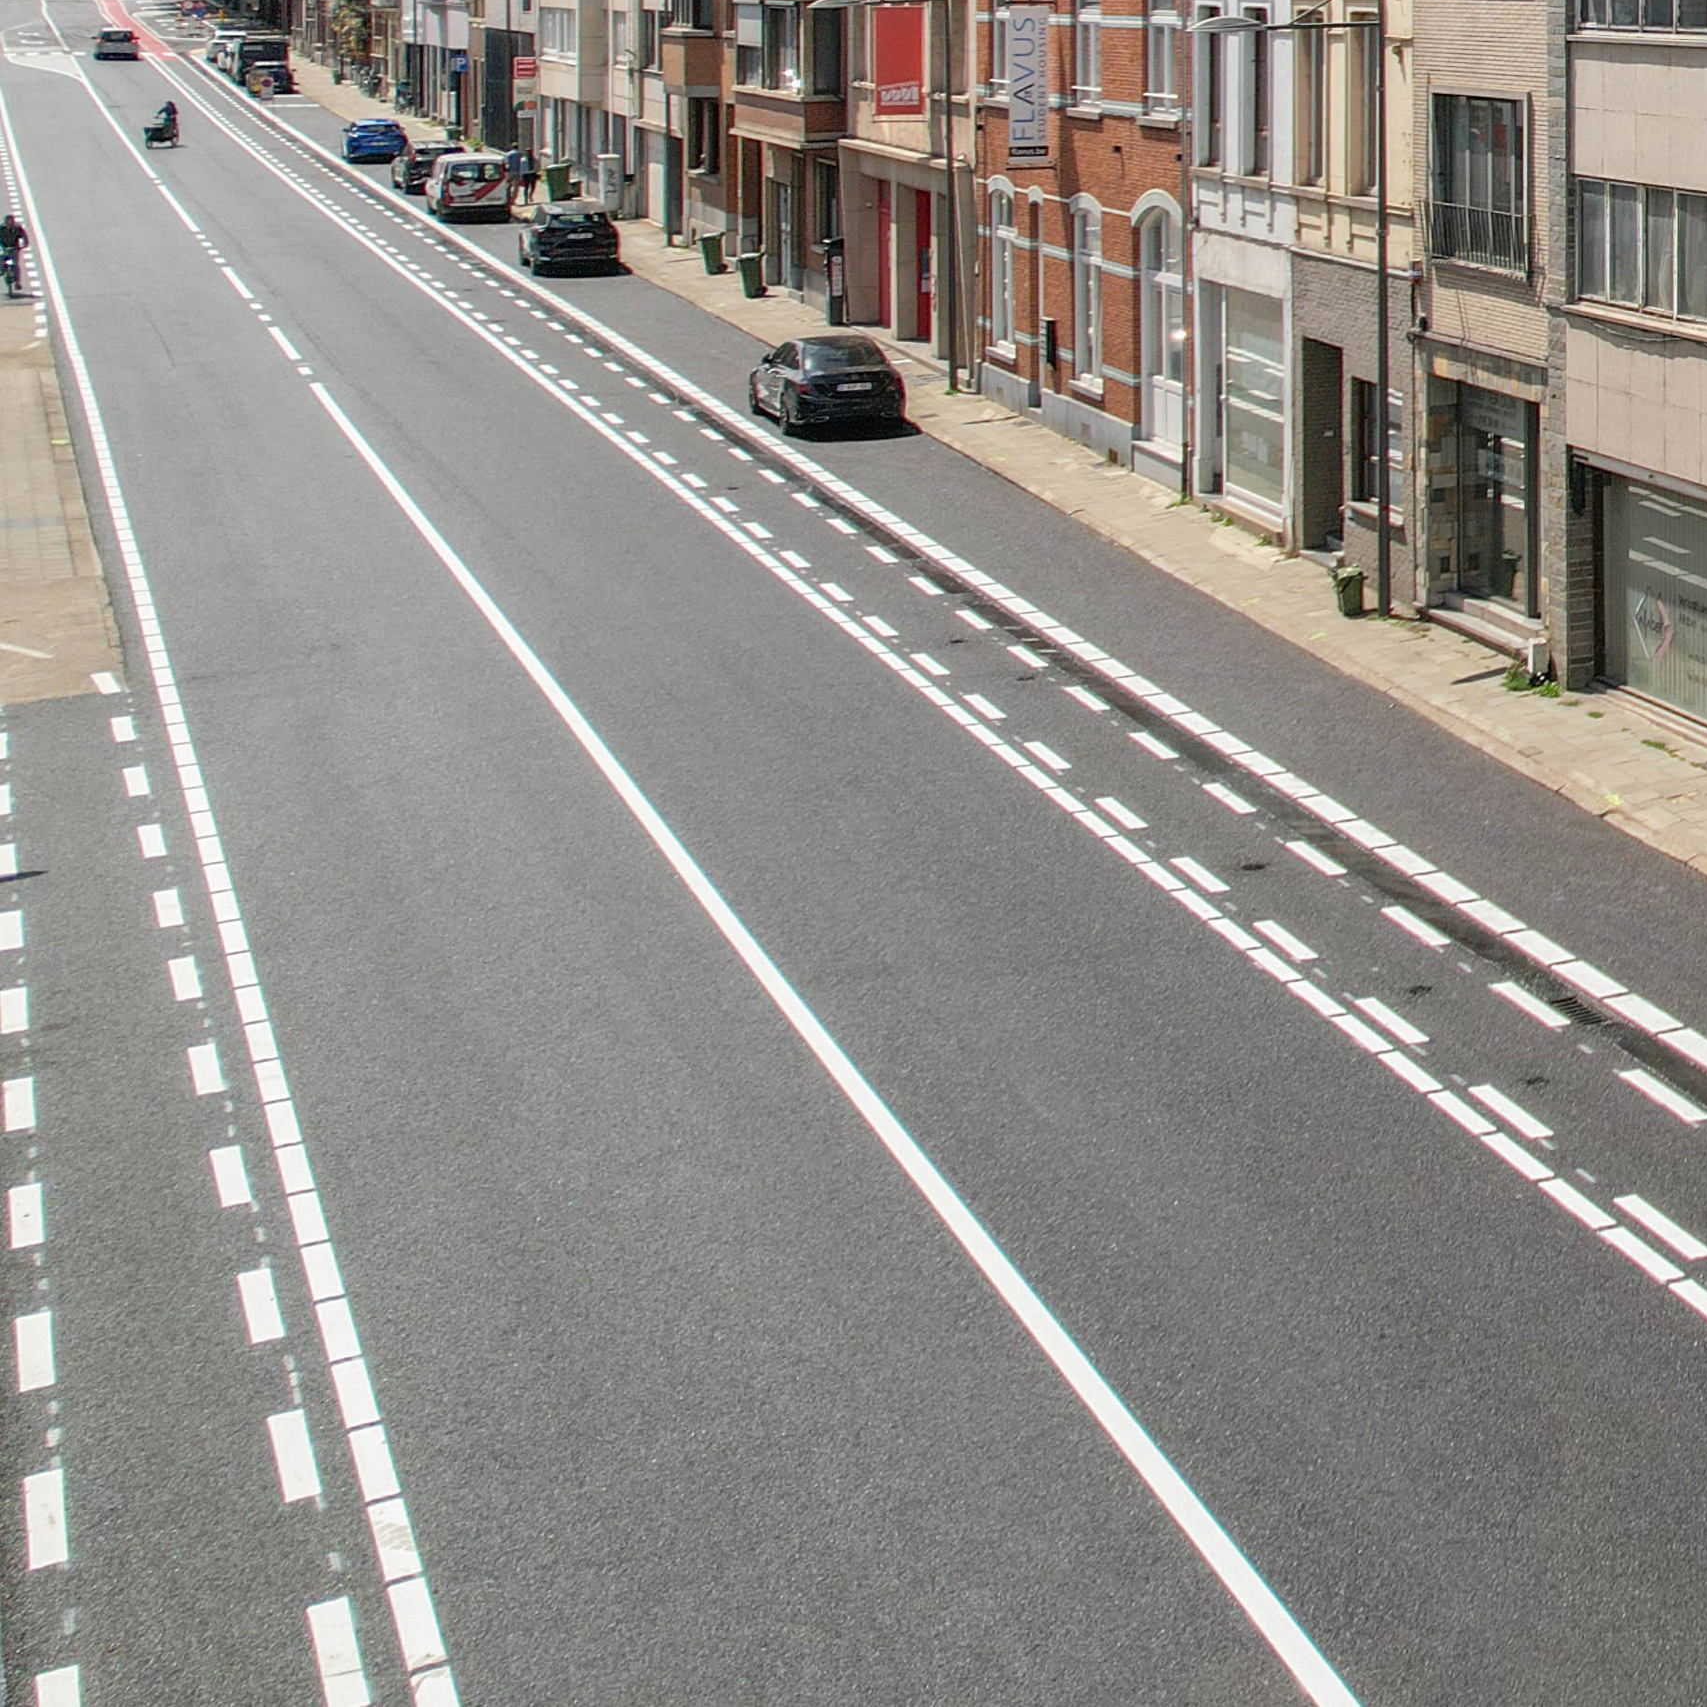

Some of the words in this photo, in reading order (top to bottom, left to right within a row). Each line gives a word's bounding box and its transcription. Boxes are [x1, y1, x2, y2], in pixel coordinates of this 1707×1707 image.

[1037, 17, 1047, 78] HOUSING
[1013, 17, 1035, 141] FLAVUS
[1037, 84, 1047, 141] STUDENT
